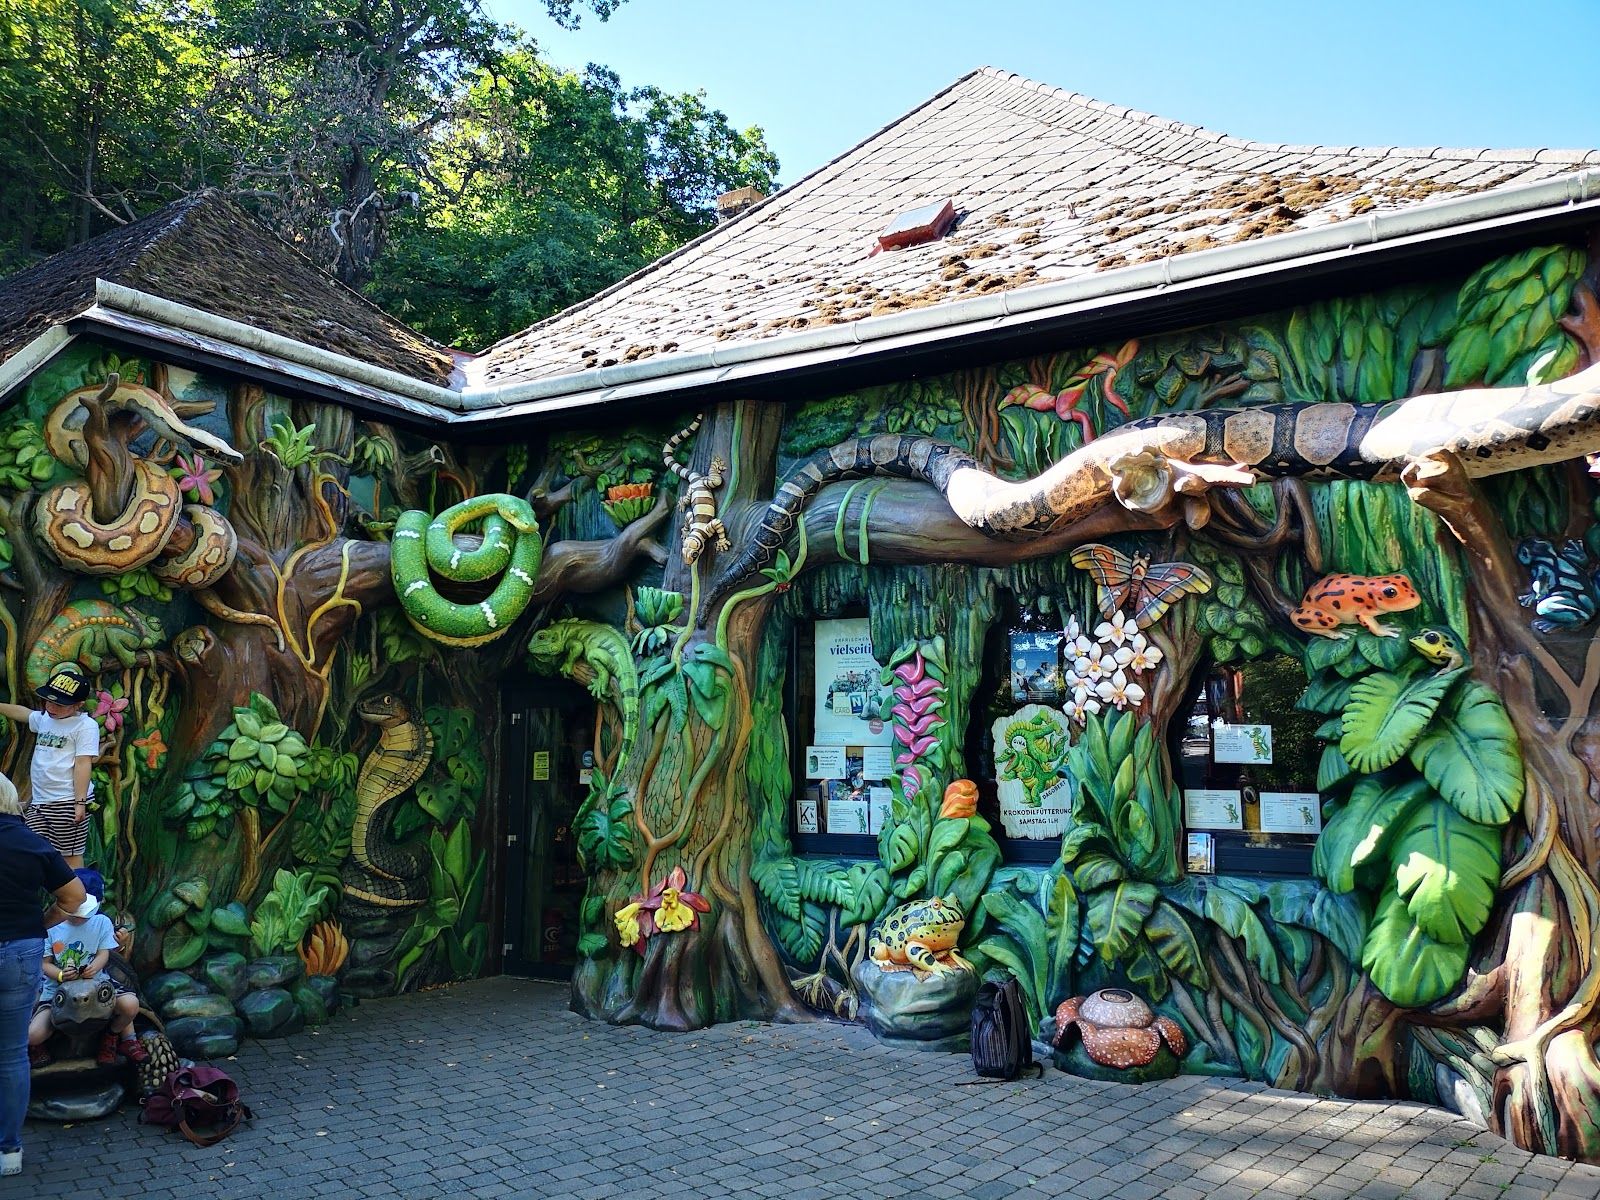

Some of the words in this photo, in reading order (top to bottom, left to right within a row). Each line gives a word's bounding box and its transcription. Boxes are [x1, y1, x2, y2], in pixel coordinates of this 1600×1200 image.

[830, 643, 871, 655] vielseiti
[1042, 780, 1067, 800] DAGOBERT
[1003, 808, 1072, 816] KROKODILFÜTTERUNG
